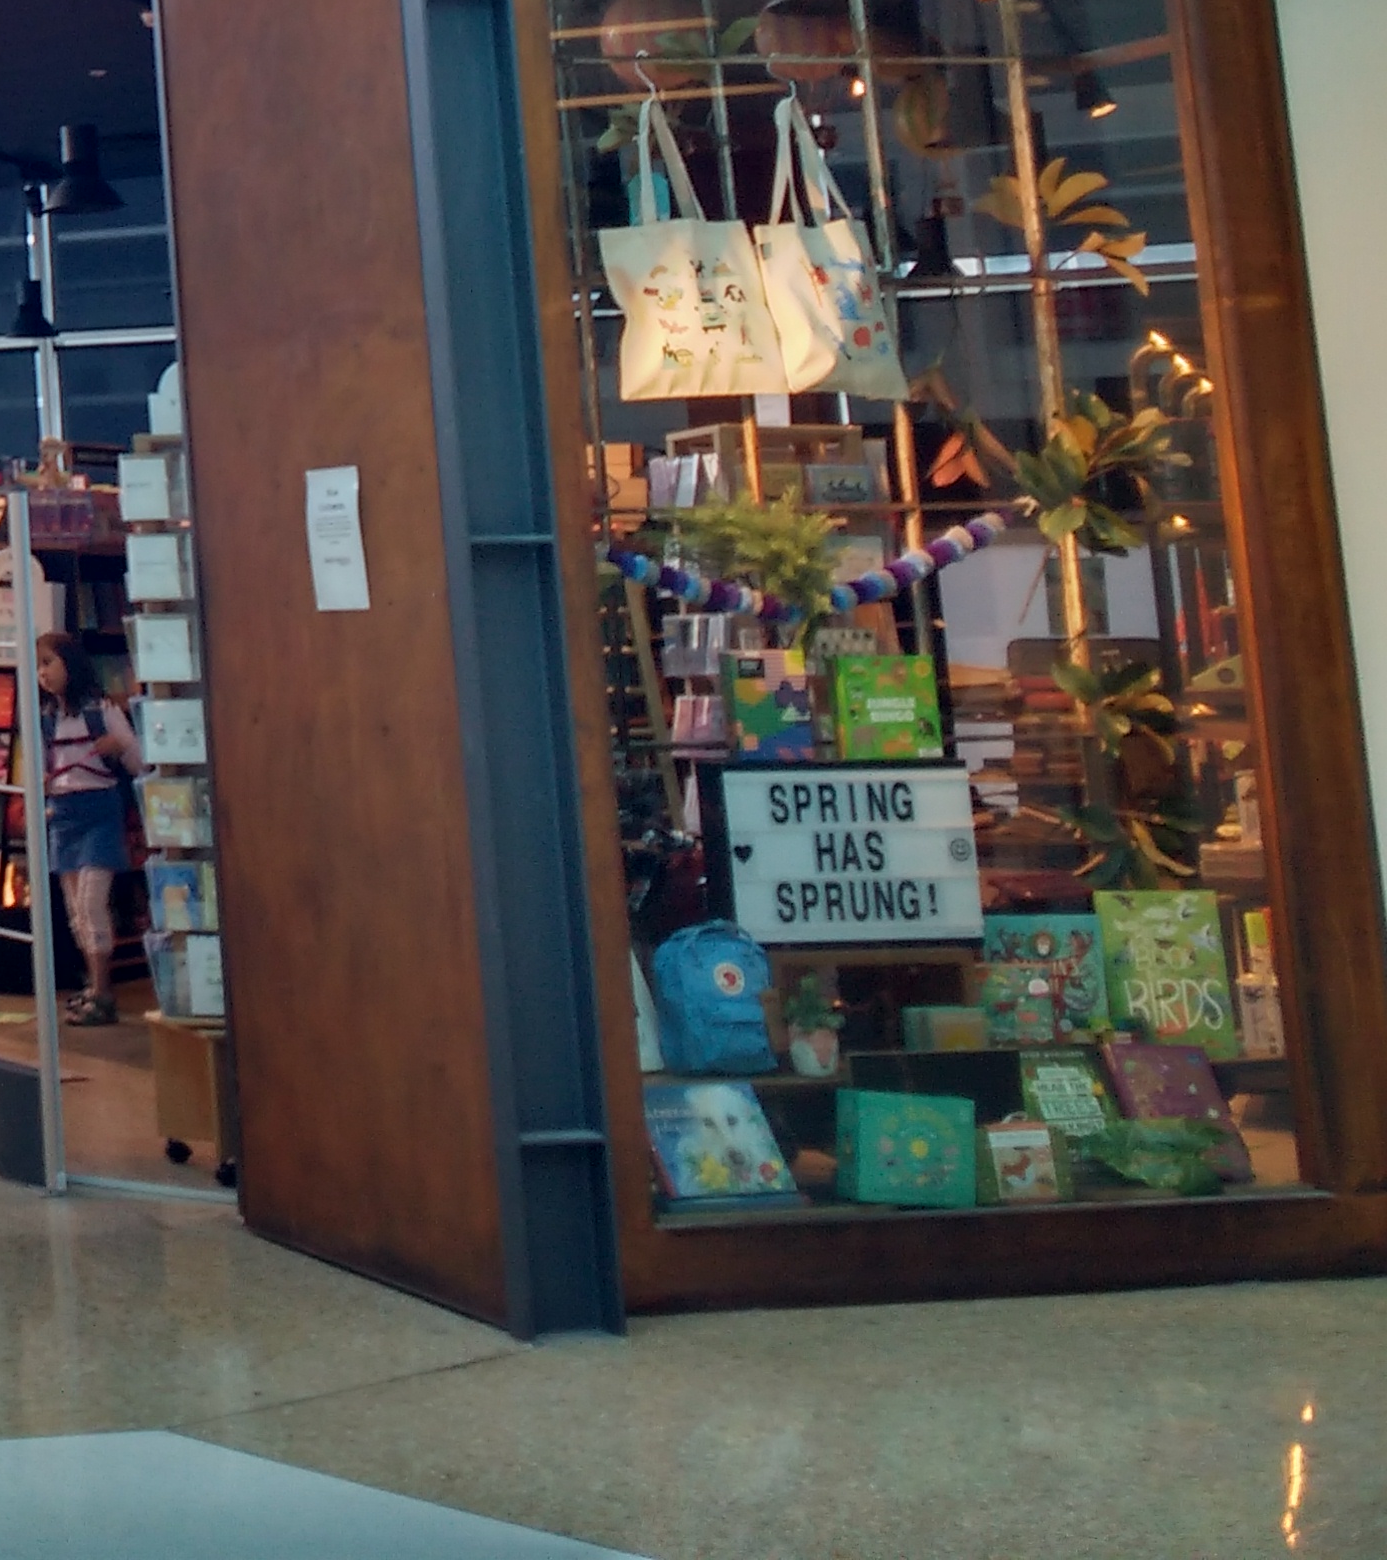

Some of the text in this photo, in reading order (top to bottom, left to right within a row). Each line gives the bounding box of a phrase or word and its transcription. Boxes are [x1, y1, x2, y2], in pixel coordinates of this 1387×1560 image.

[769, 781, 915, 824] SPRING
[815, 831, 885, 872] HAS
[777, 879, 939, 923] SPRUNG!
[1124, 978, 1224, 1030] BIRDS
